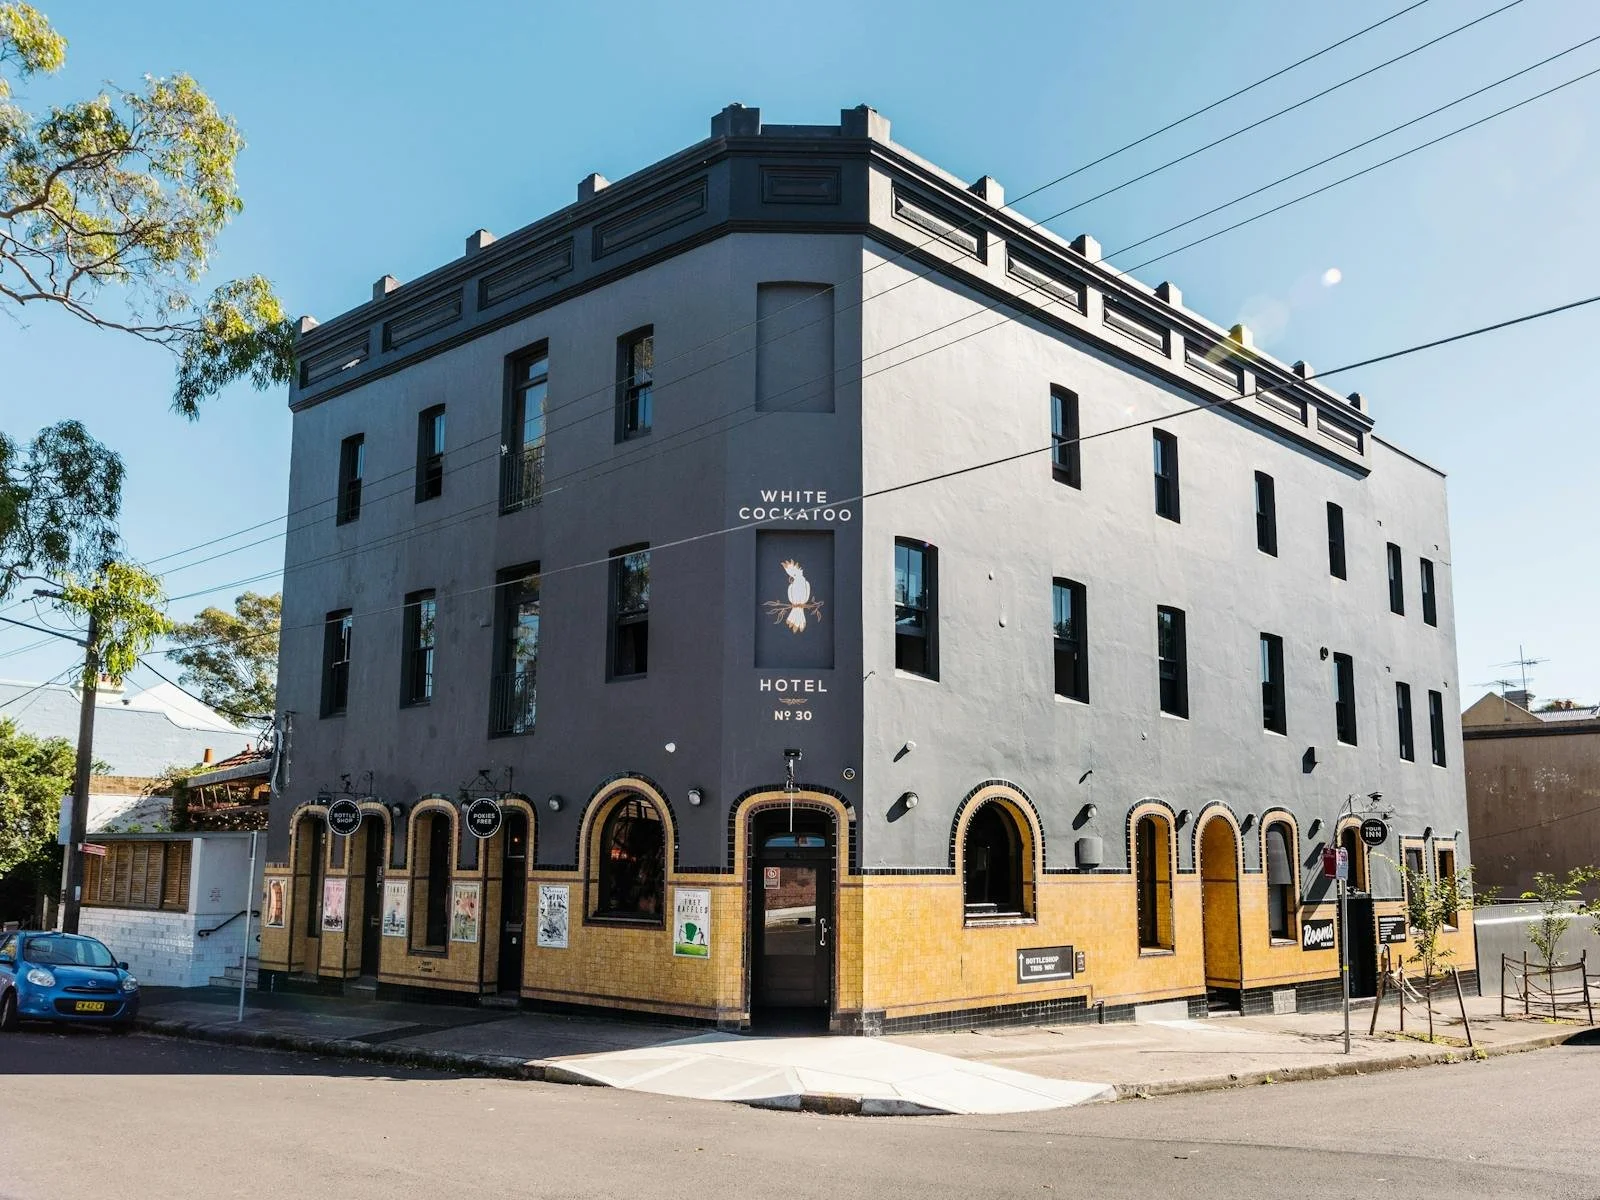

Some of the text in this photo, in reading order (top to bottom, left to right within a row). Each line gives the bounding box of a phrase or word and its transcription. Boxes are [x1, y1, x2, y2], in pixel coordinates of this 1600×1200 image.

[760, 490, 827, 504] WHITE
[738, 507, 852, 522] COCKATOO
[759, 679, 828, 693] HOTEL
[795, 710, 812, 721] 30
[684, 898, 701, 906] FREE
[677, 905, 708, 914] RAFFLES
[1303, 923, 1333, 947] Rooms
[1025, 955, 1059, 965] BOTTLESHOP
[1030, 963, 1056, 972] THIS WAY
